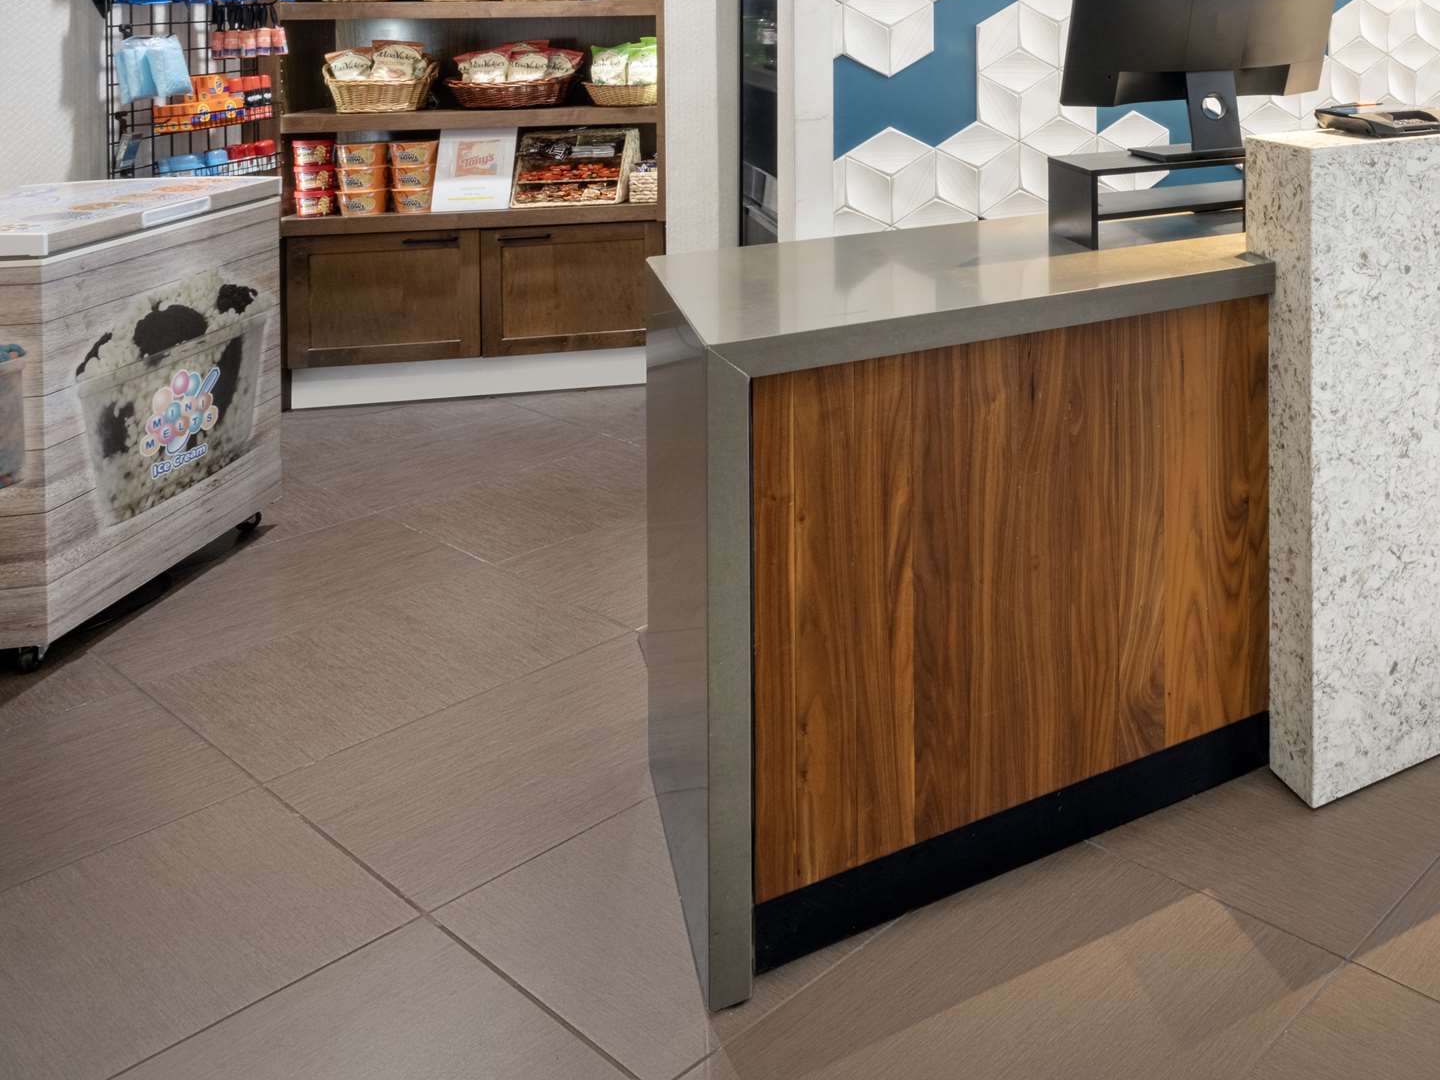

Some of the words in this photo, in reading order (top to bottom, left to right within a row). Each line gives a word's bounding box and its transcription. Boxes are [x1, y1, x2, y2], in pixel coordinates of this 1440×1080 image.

[153, 399, 205, 429] MINI
[145, 415, 213, 450] MELTS
[152, 461, 172, 479] Ice
